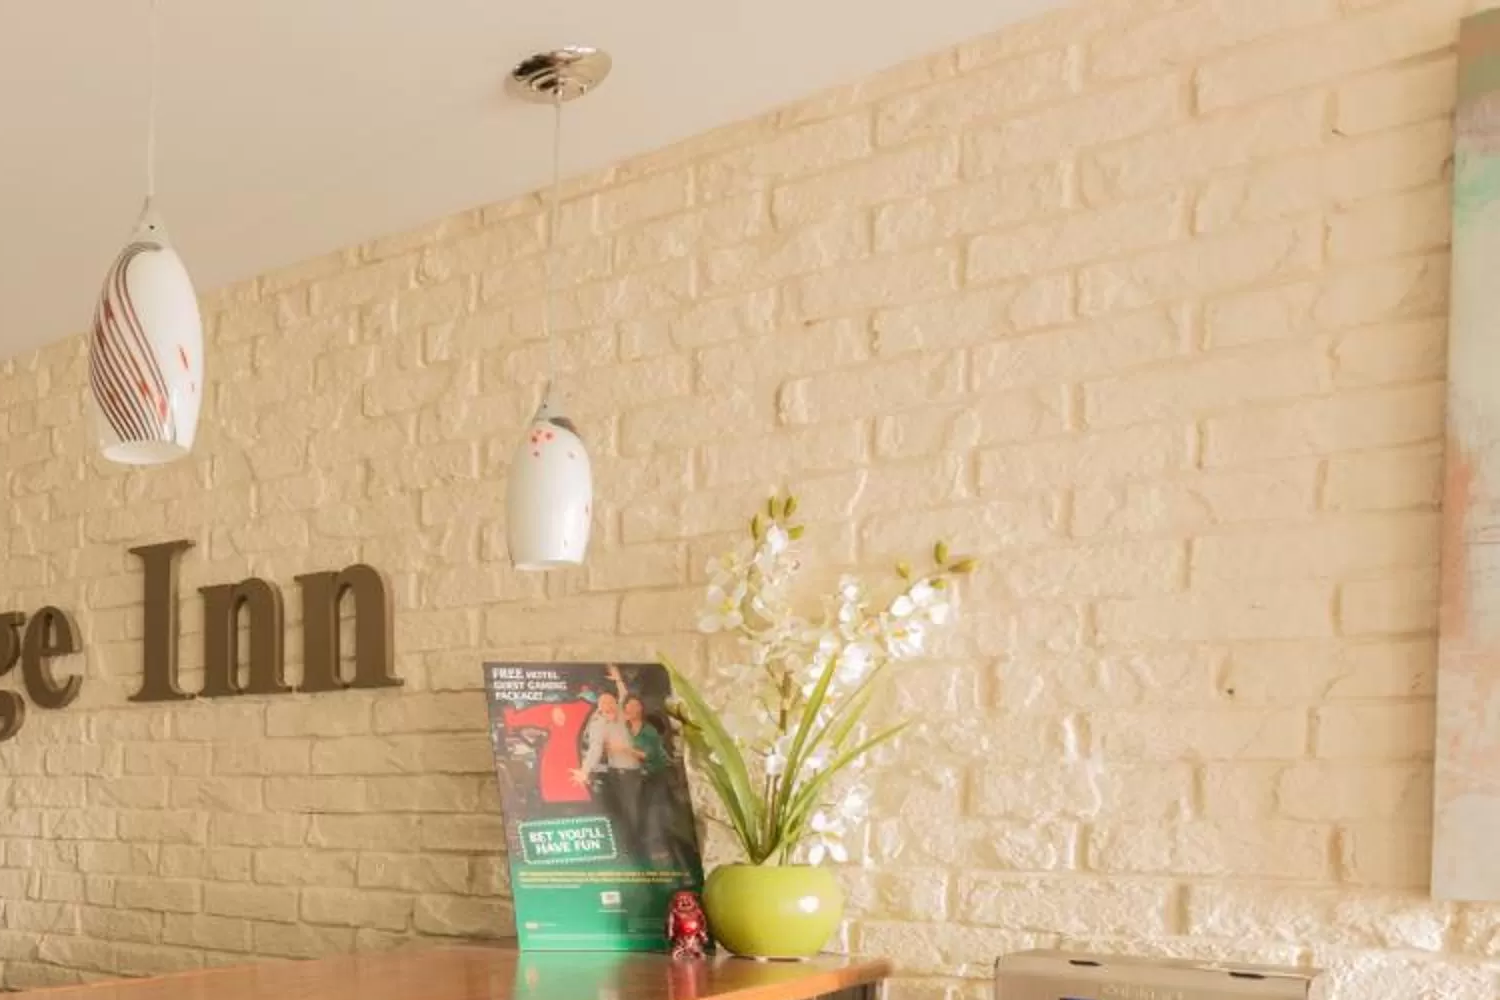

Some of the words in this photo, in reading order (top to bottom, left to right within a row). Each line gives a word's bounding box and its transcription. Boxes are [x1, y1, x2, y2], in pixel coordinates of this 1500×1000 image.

[128, 540, 403, 701] Inn
[492, 667, 524, 679] FREE
[527, 680, 568, 690] GAMING
[529, 831, 553, 844] BET
[558, 828, 605, 841] YOU'LL
[535, 841, 571, 855] HAVE
[574, 838, 601, 850] FUN
